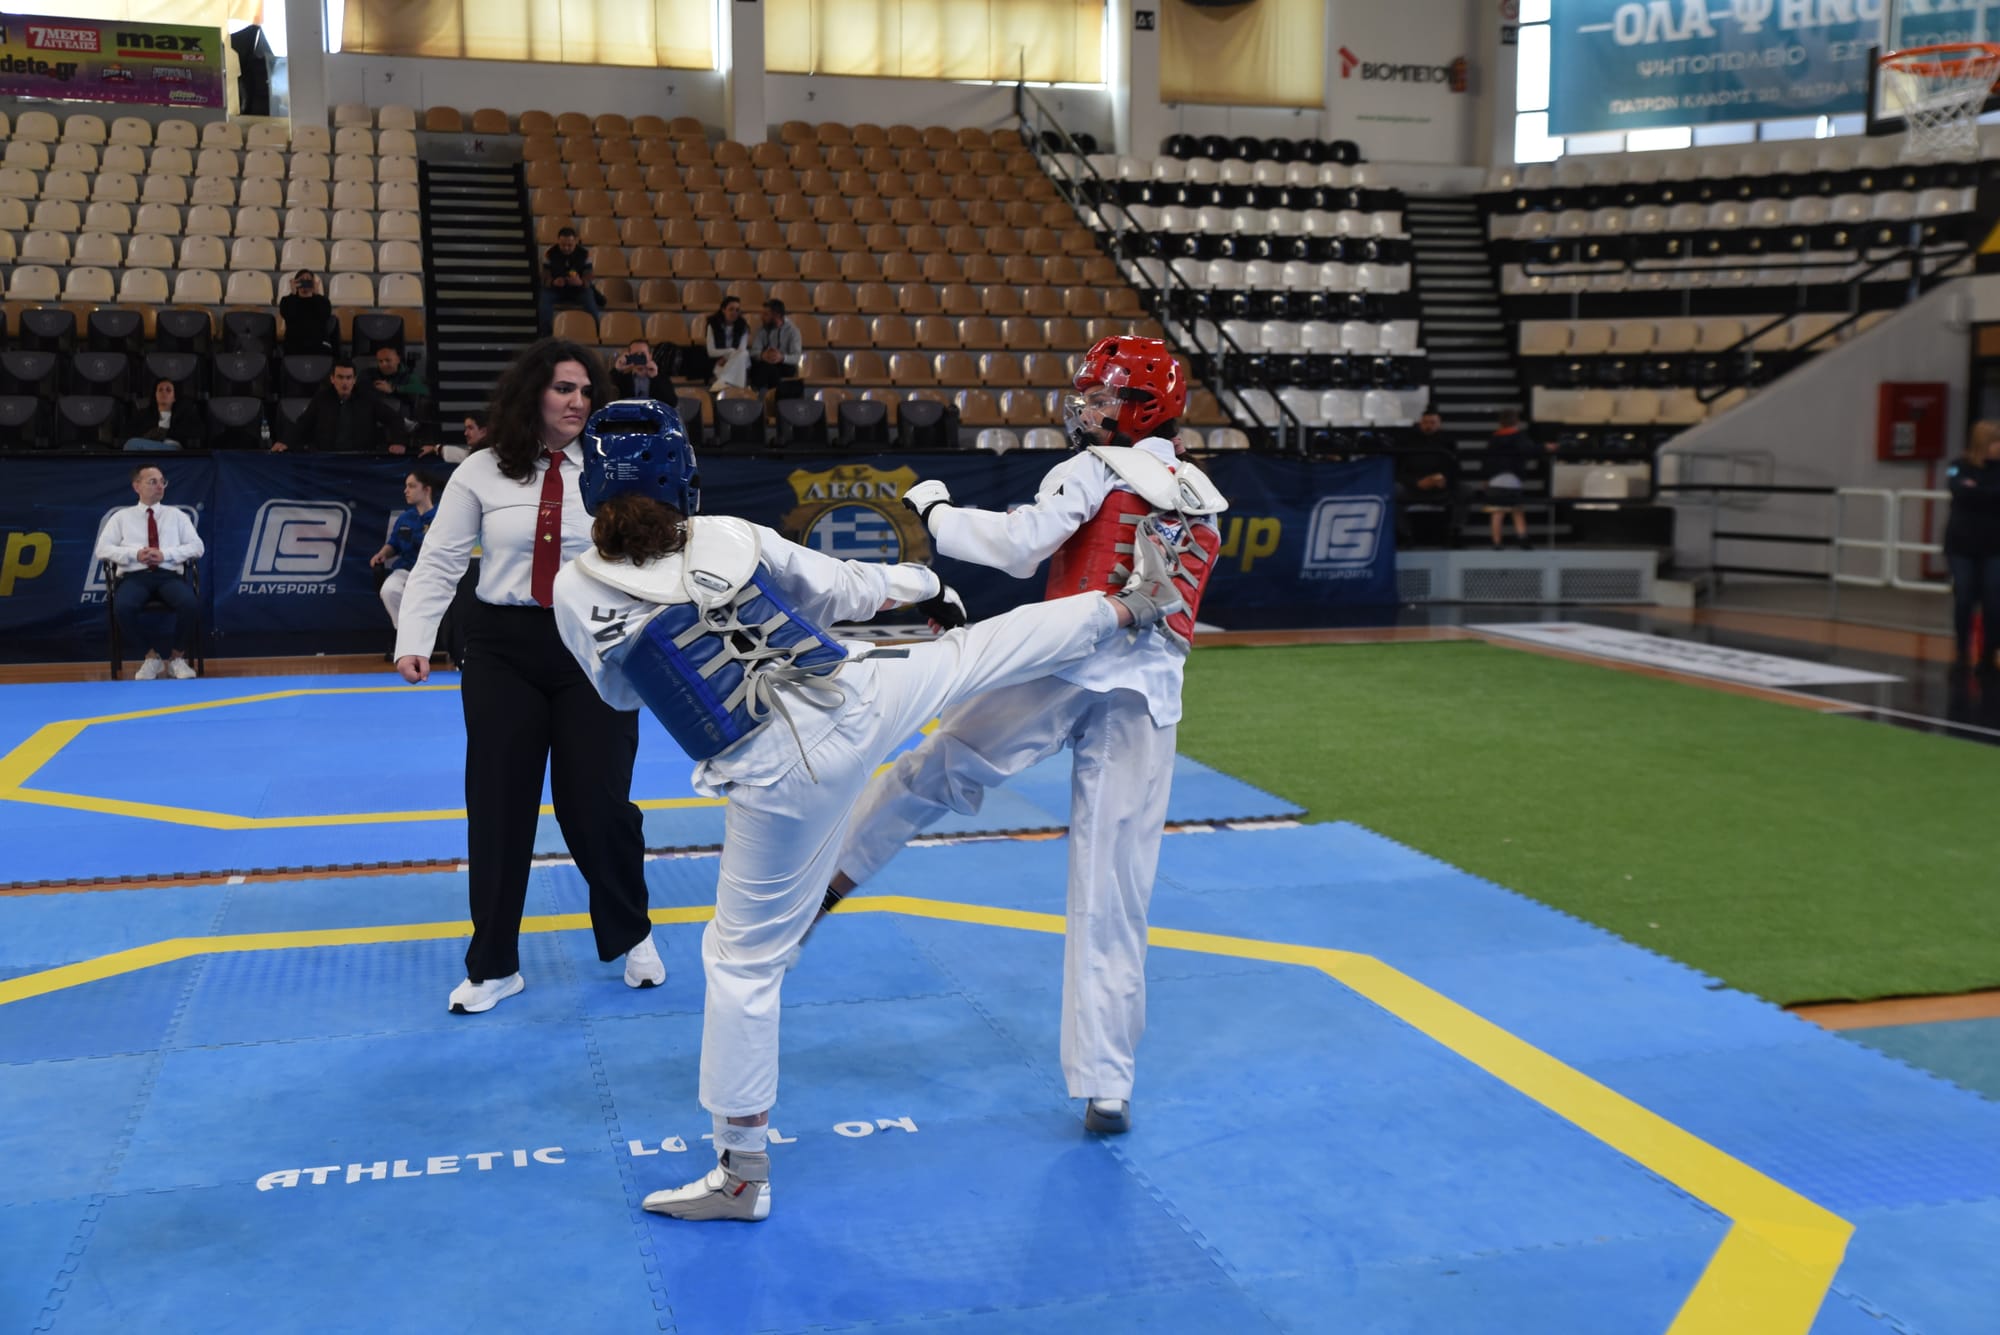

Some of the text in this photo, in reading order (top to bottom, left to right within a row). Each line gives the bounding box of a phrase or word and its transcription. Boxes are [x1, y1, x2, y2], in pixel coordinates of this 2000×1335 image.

[29, 27, 97, 47] 7 ΜΕΡΕΣ
[116, 32, 203, 52] max
[238, 583, 337, 595] PLAYSPORTS
[256, 1146, 567, 1192] ATHLETIC
[833, 1116, 919, 1139] ON
